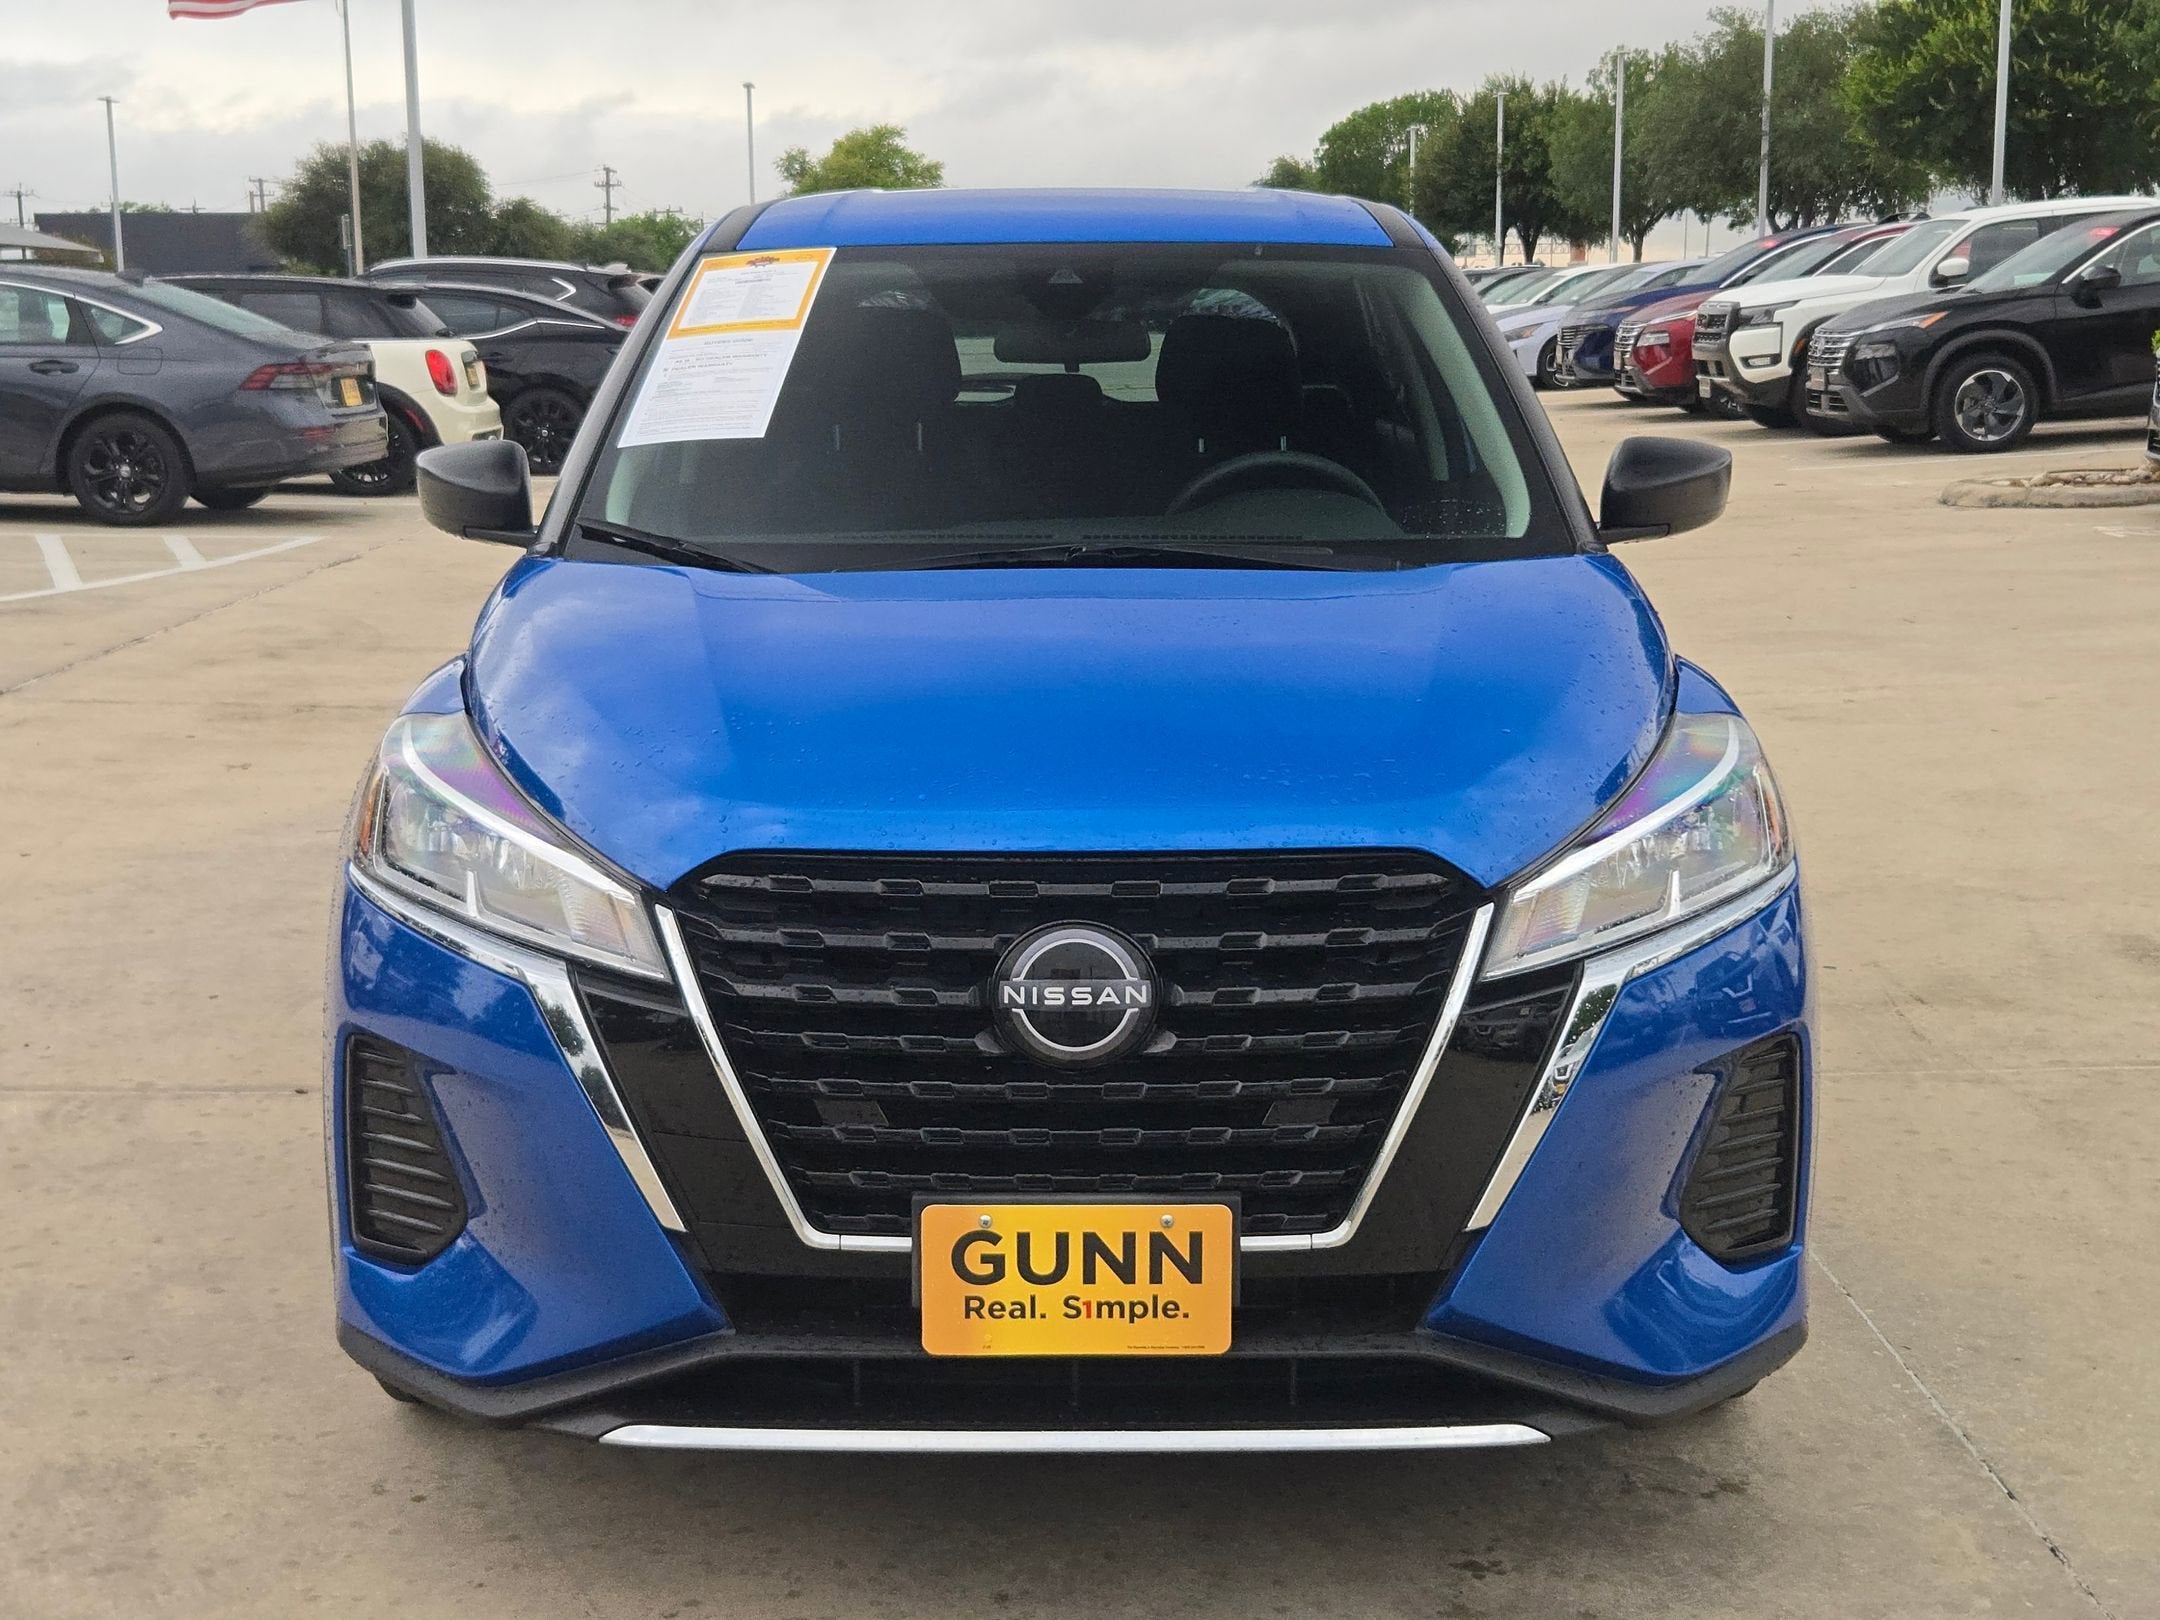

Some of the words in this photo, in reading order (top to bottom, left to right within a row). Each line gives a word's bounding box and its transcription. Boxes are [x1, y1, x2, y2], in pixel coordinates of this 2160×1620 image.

[1003, 985, 1147, 1006] NISSAN
[951, 1229, 1203, 1286] GUNN
[964, 1295, 1047, 1320] Real.
